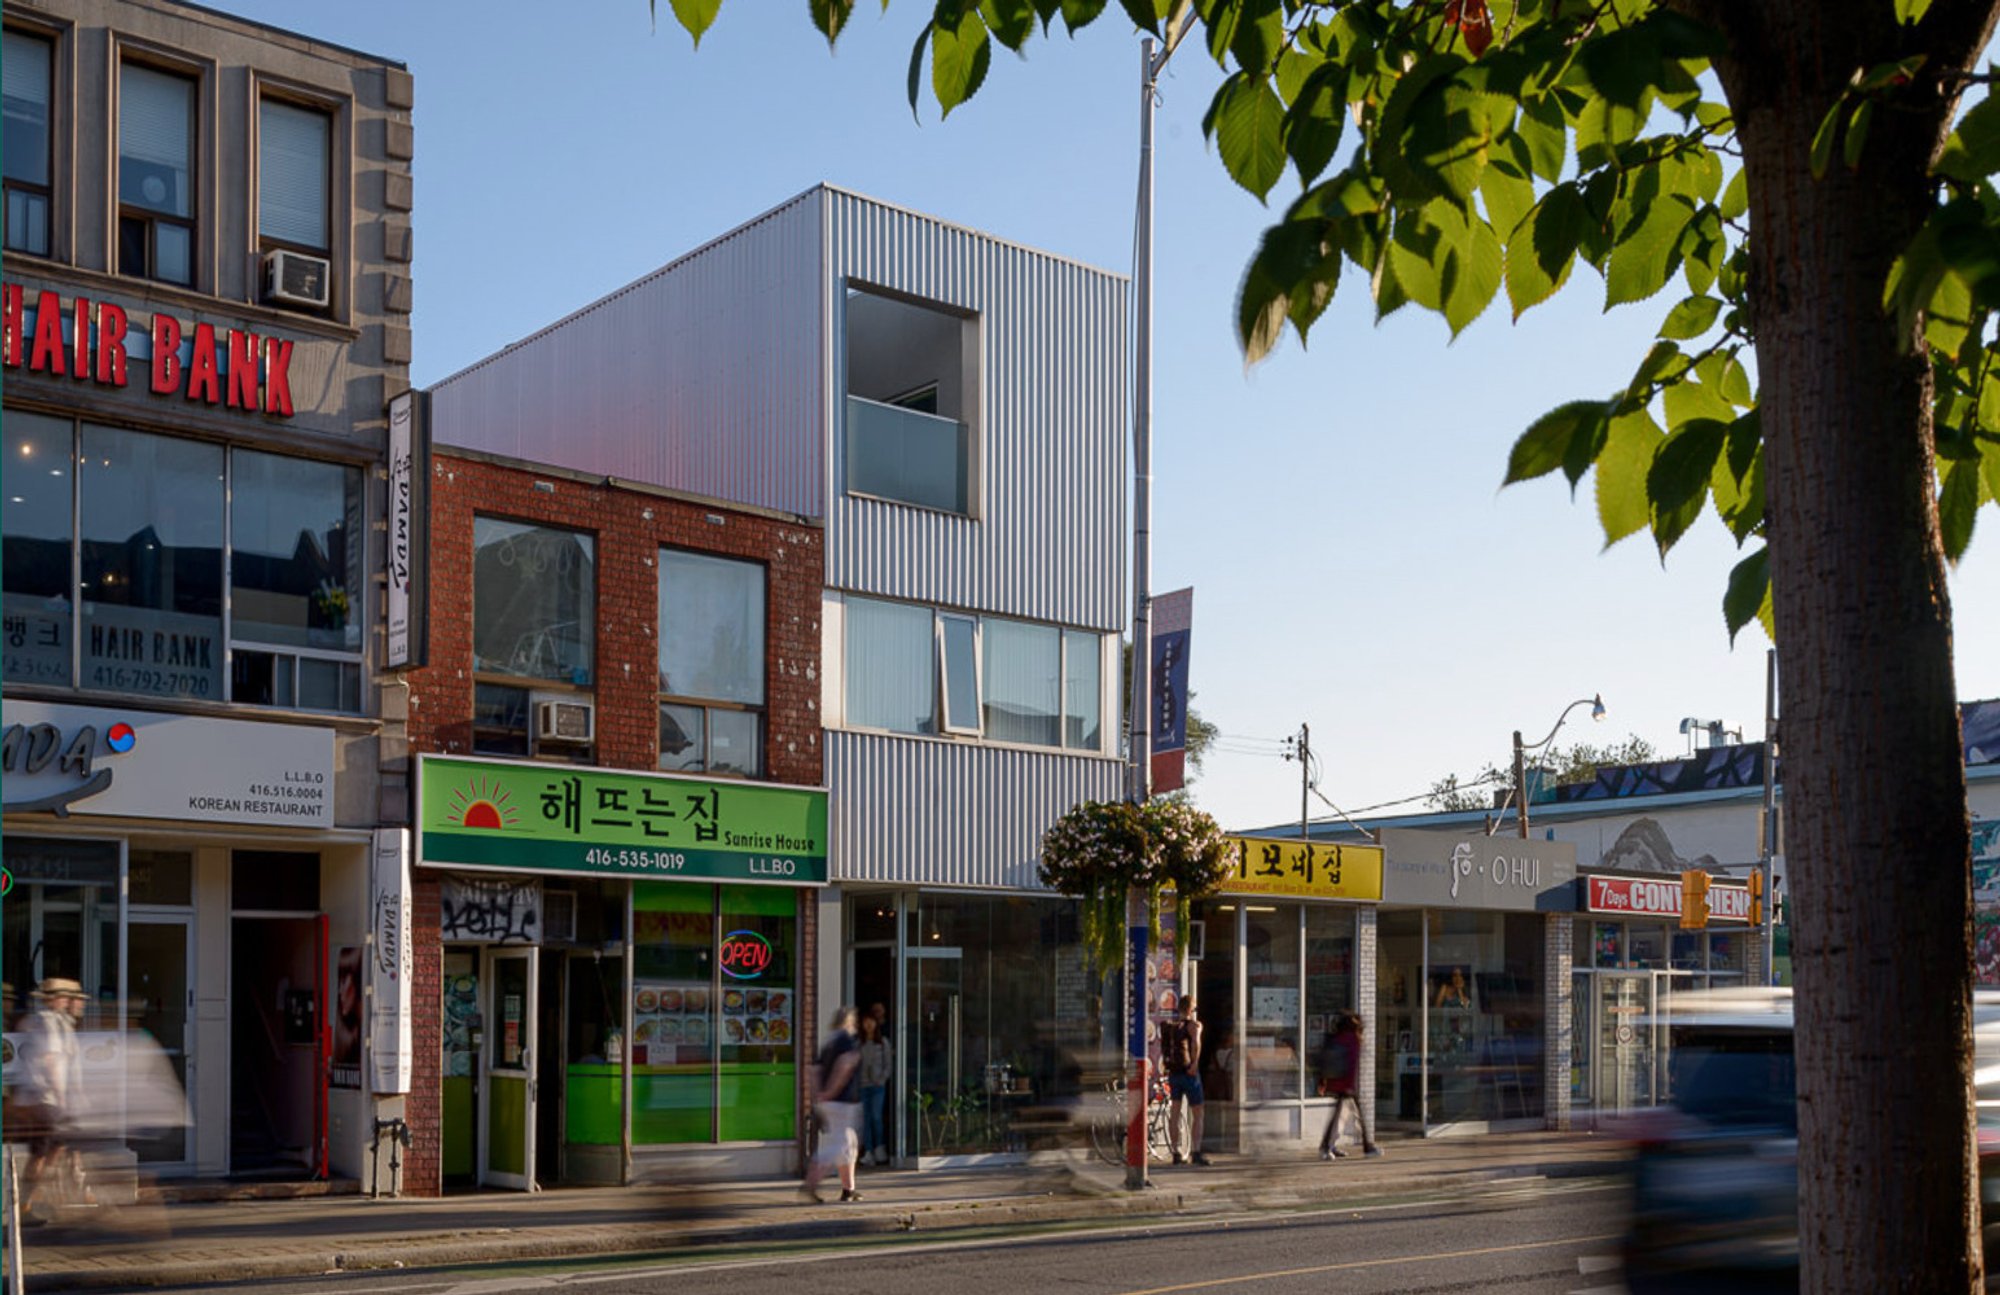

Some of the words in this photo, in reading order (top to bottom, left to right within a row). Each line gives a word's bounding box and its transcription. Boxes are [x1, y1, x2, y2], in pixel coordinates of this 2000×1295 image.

[2, 281, 128, 387] HAIR
[151, 312, 295, 417] BANK
[91, 624, 144, 662] HAIR
[153, 630, 212, 670] BANK
[93, 665, 209, 696] 416-792-7020
[249, 784, 323, 800] 416.516.0004
[189, 796, 241, 811] KOREAN
[244, 801, 323, 817] RESTAURANT
[539, 775, 720, 842] 해뜨는집
[723, 830, 772, 849] Sunrise
[775, 836, 815, 851] House
[585, 847, 685, 870] 416-535-1019
[1239, 839, 1342, 885] 모네집
[1597, 880, 1608, 908] 7
[1606, 889, 1629, 908] Days
[720, 942, 768, 967] OPEN
